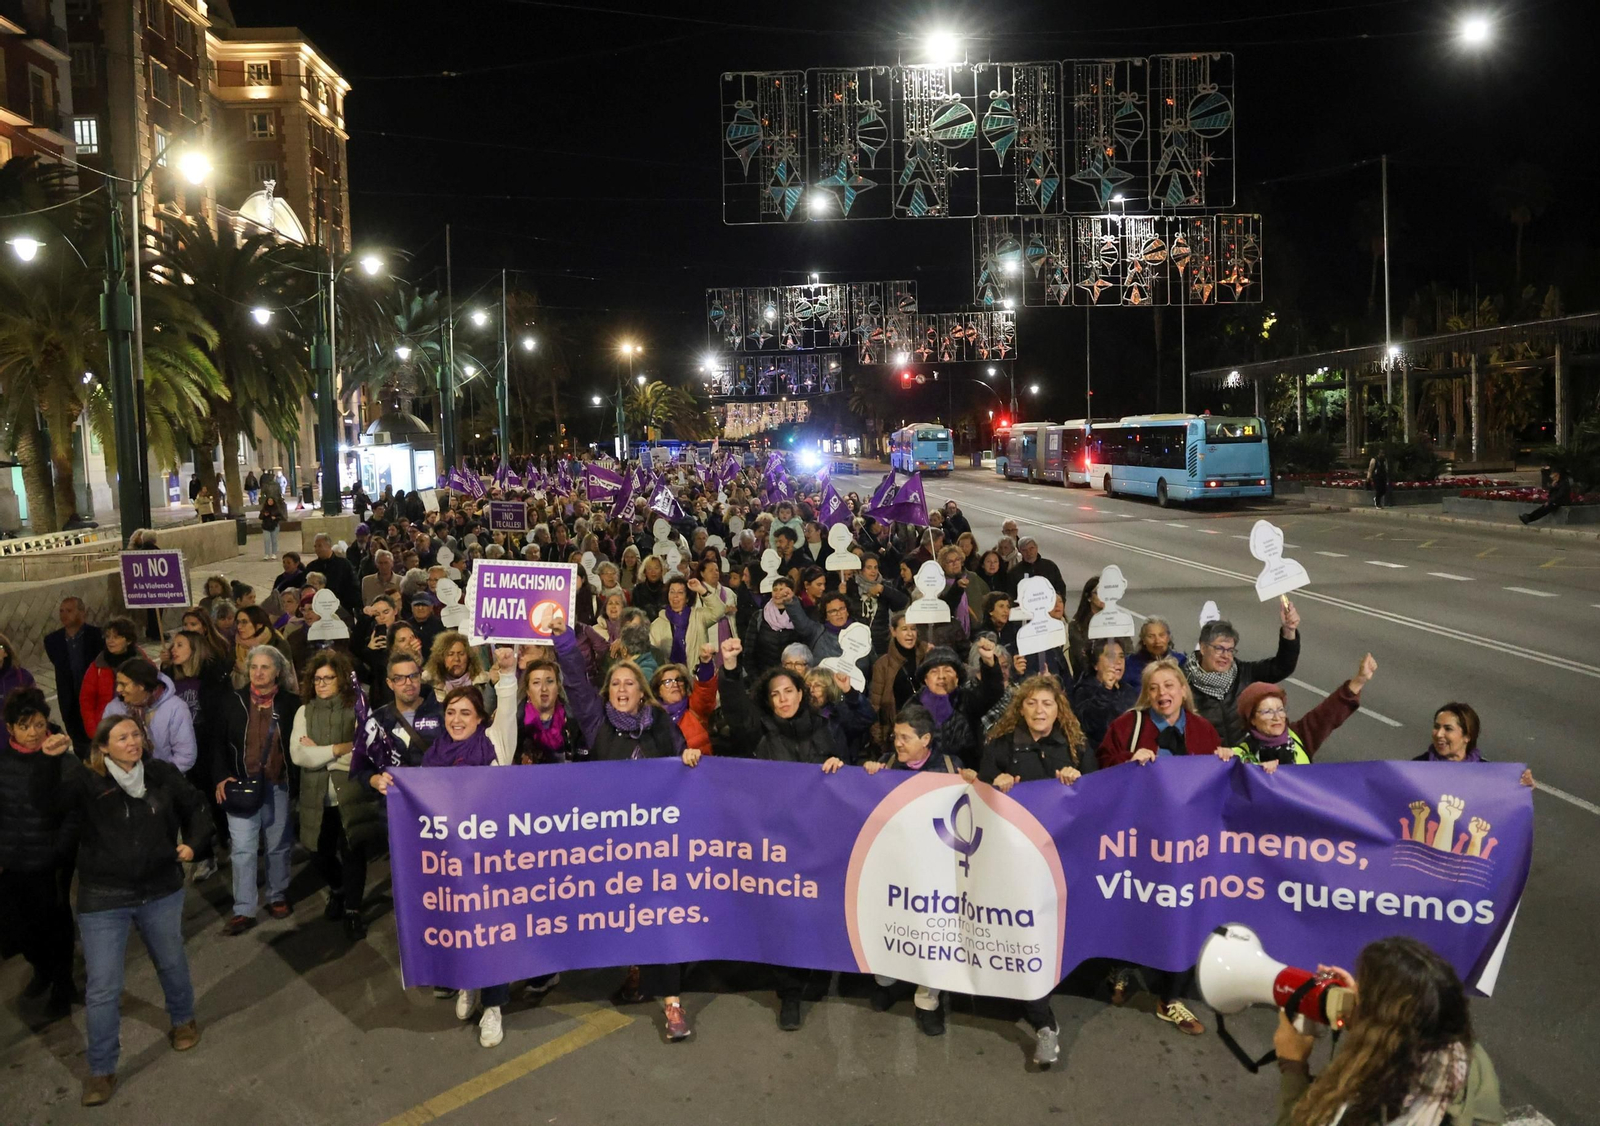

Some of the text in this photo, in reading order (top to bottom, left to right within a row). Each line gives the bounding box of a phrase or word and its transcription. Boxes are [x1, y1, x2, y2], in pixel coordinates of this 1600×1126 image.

[1244, 426, 1253, 435] 21
[132, 557, 168, 577] DI NO
[483, 572, 565, 591] EL MACHISMO
[158, 591, 183, 599] mujeres
[481, 597, 527, 620] MATA
[418, 803, 681, 840] 25 de Noviembre
[421, 833, 788, 877] Día Internacional para la
[1098, 828, 1370, 871] Ni una menos,
[422, 866, 819, 914] eliminación de la violencia
[887, 884, 1034, 928] Plataforma
[1095, 870, 1496, 926] Vivas nos queremos
[424, 902, 710, 949] contra las mujeres.
[884, 921, 1041, 955] violencias machistas
[926, 916, 991, 938] contra las
[883, 936, 1043, 974] VIOLENCIA CERO
